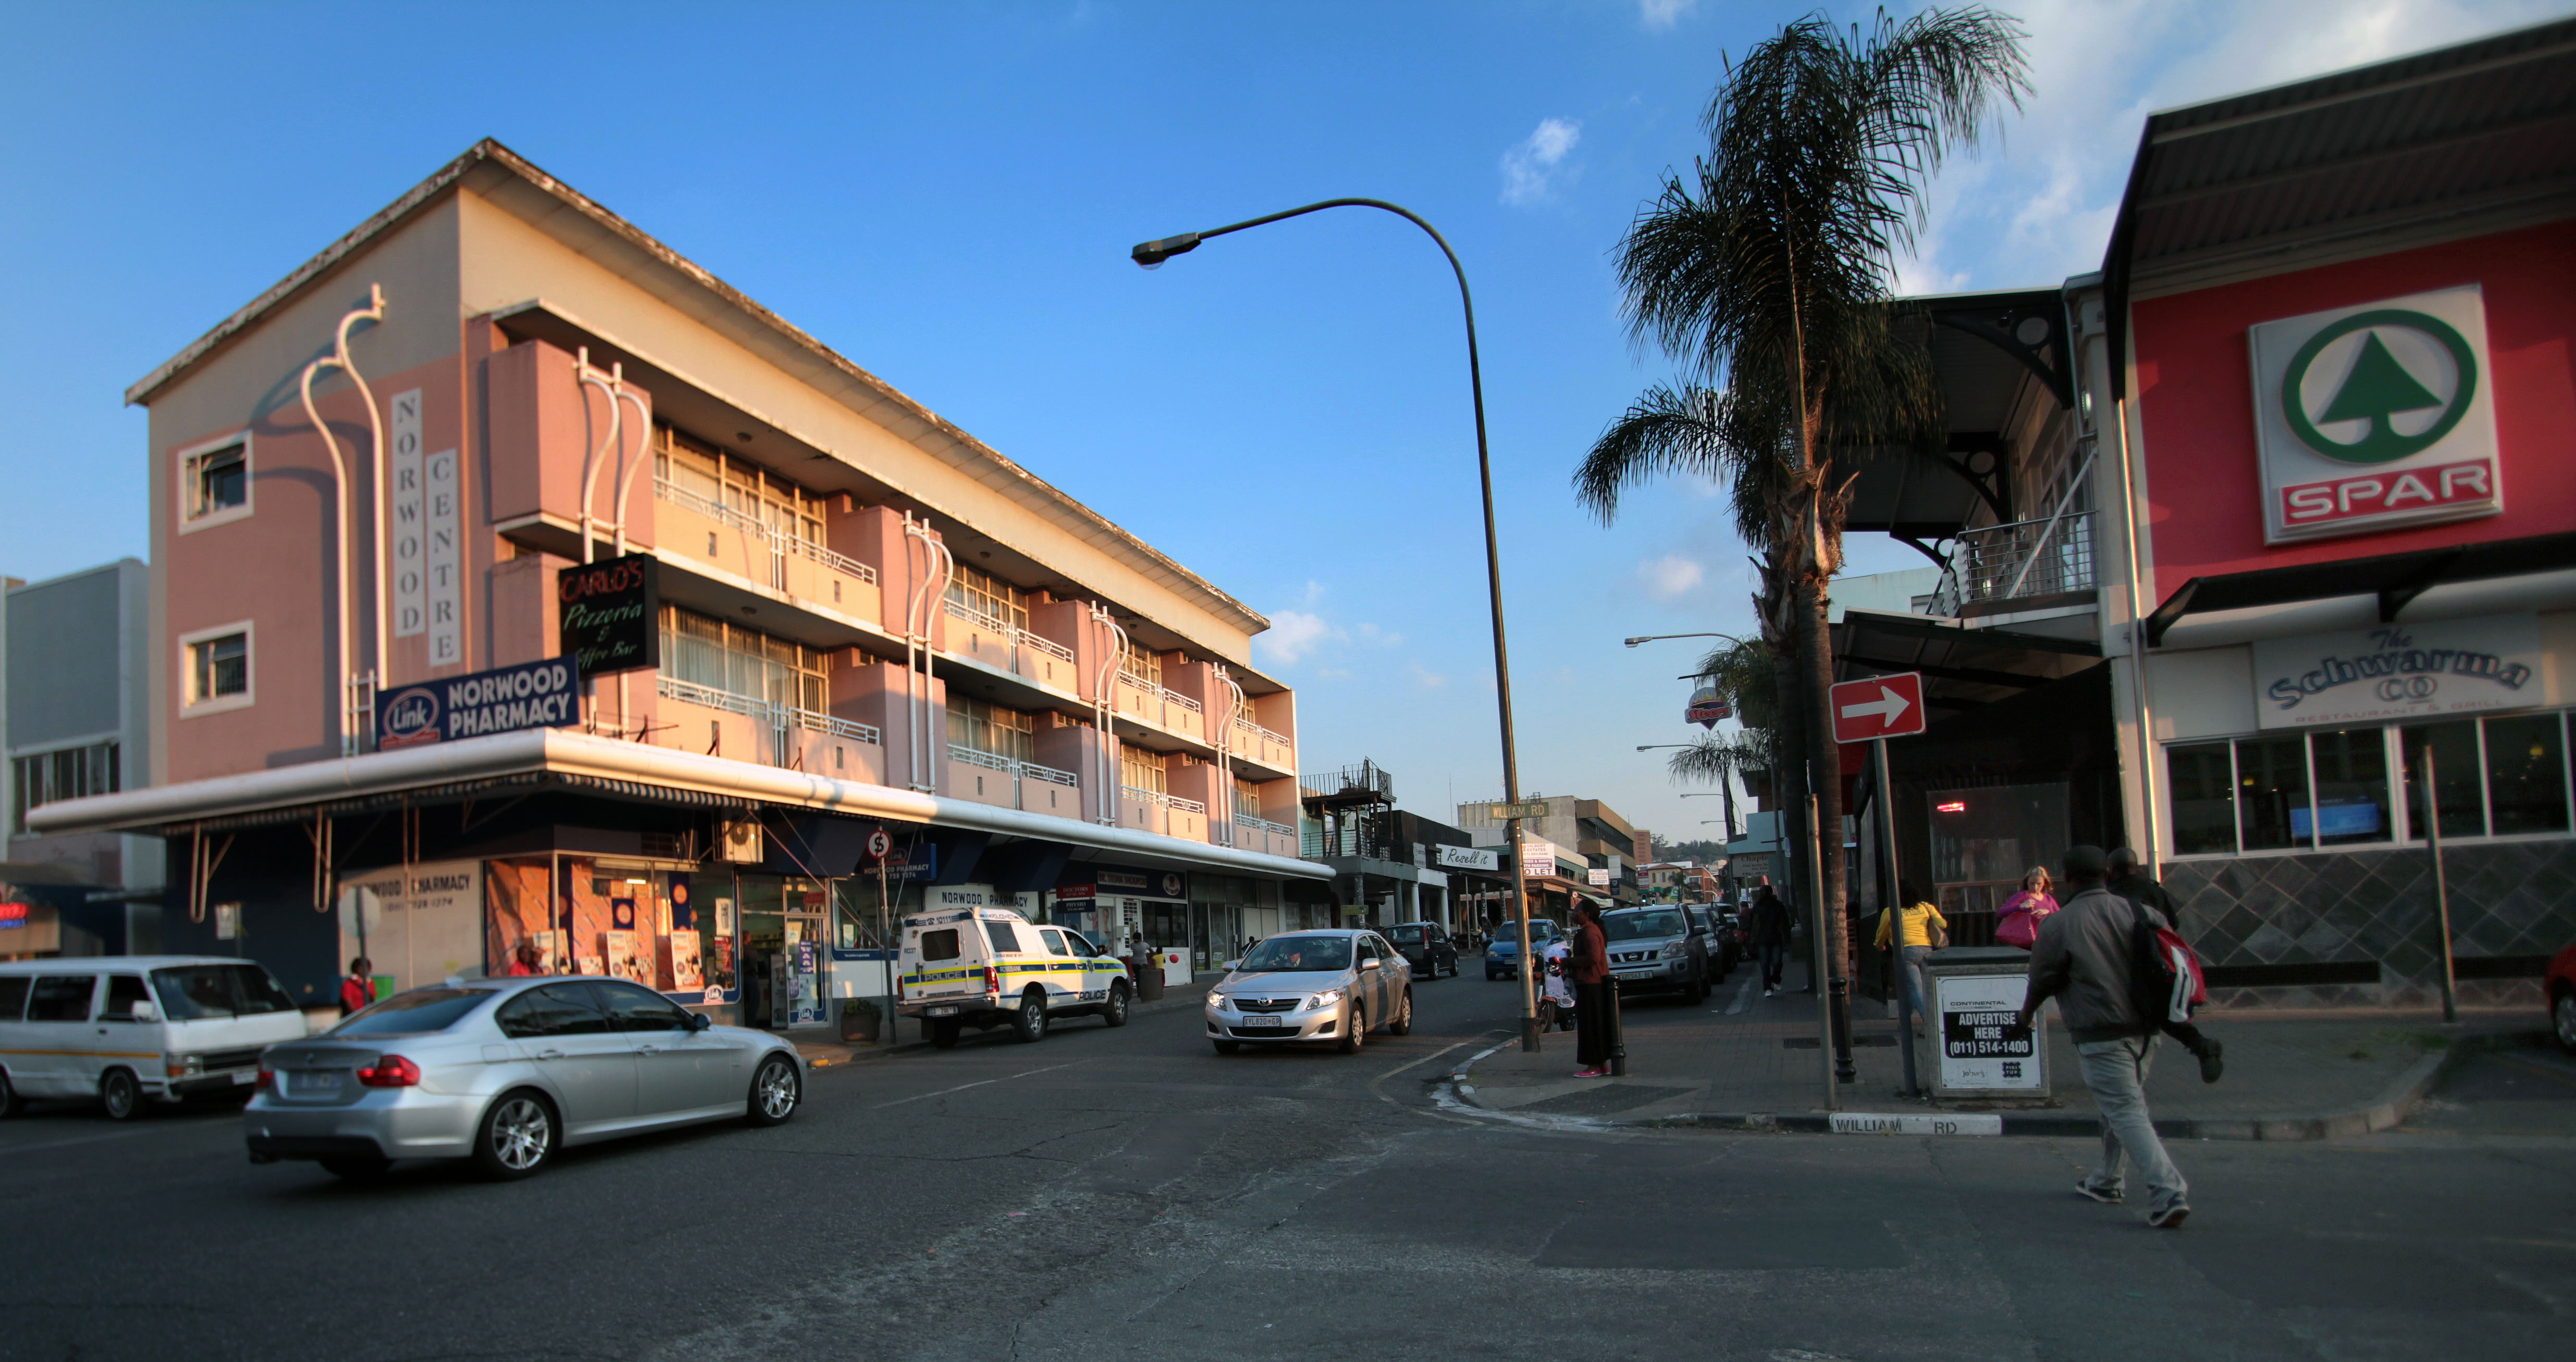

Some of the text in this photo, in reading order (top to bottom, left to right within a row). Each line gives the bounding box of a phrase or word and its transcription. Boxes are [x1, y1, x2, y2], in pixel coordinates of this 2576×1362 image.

[2288, 465, 2487, 519] SPAR
[398, 397, 419, 631] NORWOOD
[432, 456, 454, 659] CENTRE
[561, 560, 645, 603] CARLO'S
[564, 600, 643, 630] Pizzeria
[612, 640, 637, 658] Bar
[2369, 629, 2413, 650] The
[448, 664, 568, 710] NORWOOD
[2269, 648, 2531, 710] Schwarma
[392, 700, 428, 730] Link
[449, 692, 571, 738] PHARMACY
[1687, 707, 1730, 720] Steers
[2296, 699, 2502, 723] RESTAURANT & GRILL
[1493, 804, 1545, 817] WILLIAM RD
[1447, 848, 1488, 865] Resell it
[411, 874, 470, 895] PHARMACY
[942, 892, 1028, 907] NORWOOD PHARMACY
[936, 915, 952, 924] 10111
[924, 971, 962, 982] POLICE
[1078, 989, 1106, 1001] POLICE
[1958, 1012, 2017, 1025] ADVERTISE
[1974, 1027, 2002, 1039] HERE
[1950, 1040, 2029, 1056] (011) 514-1400
[1836, 1119, 1957, 1134] WILLIAM RD
